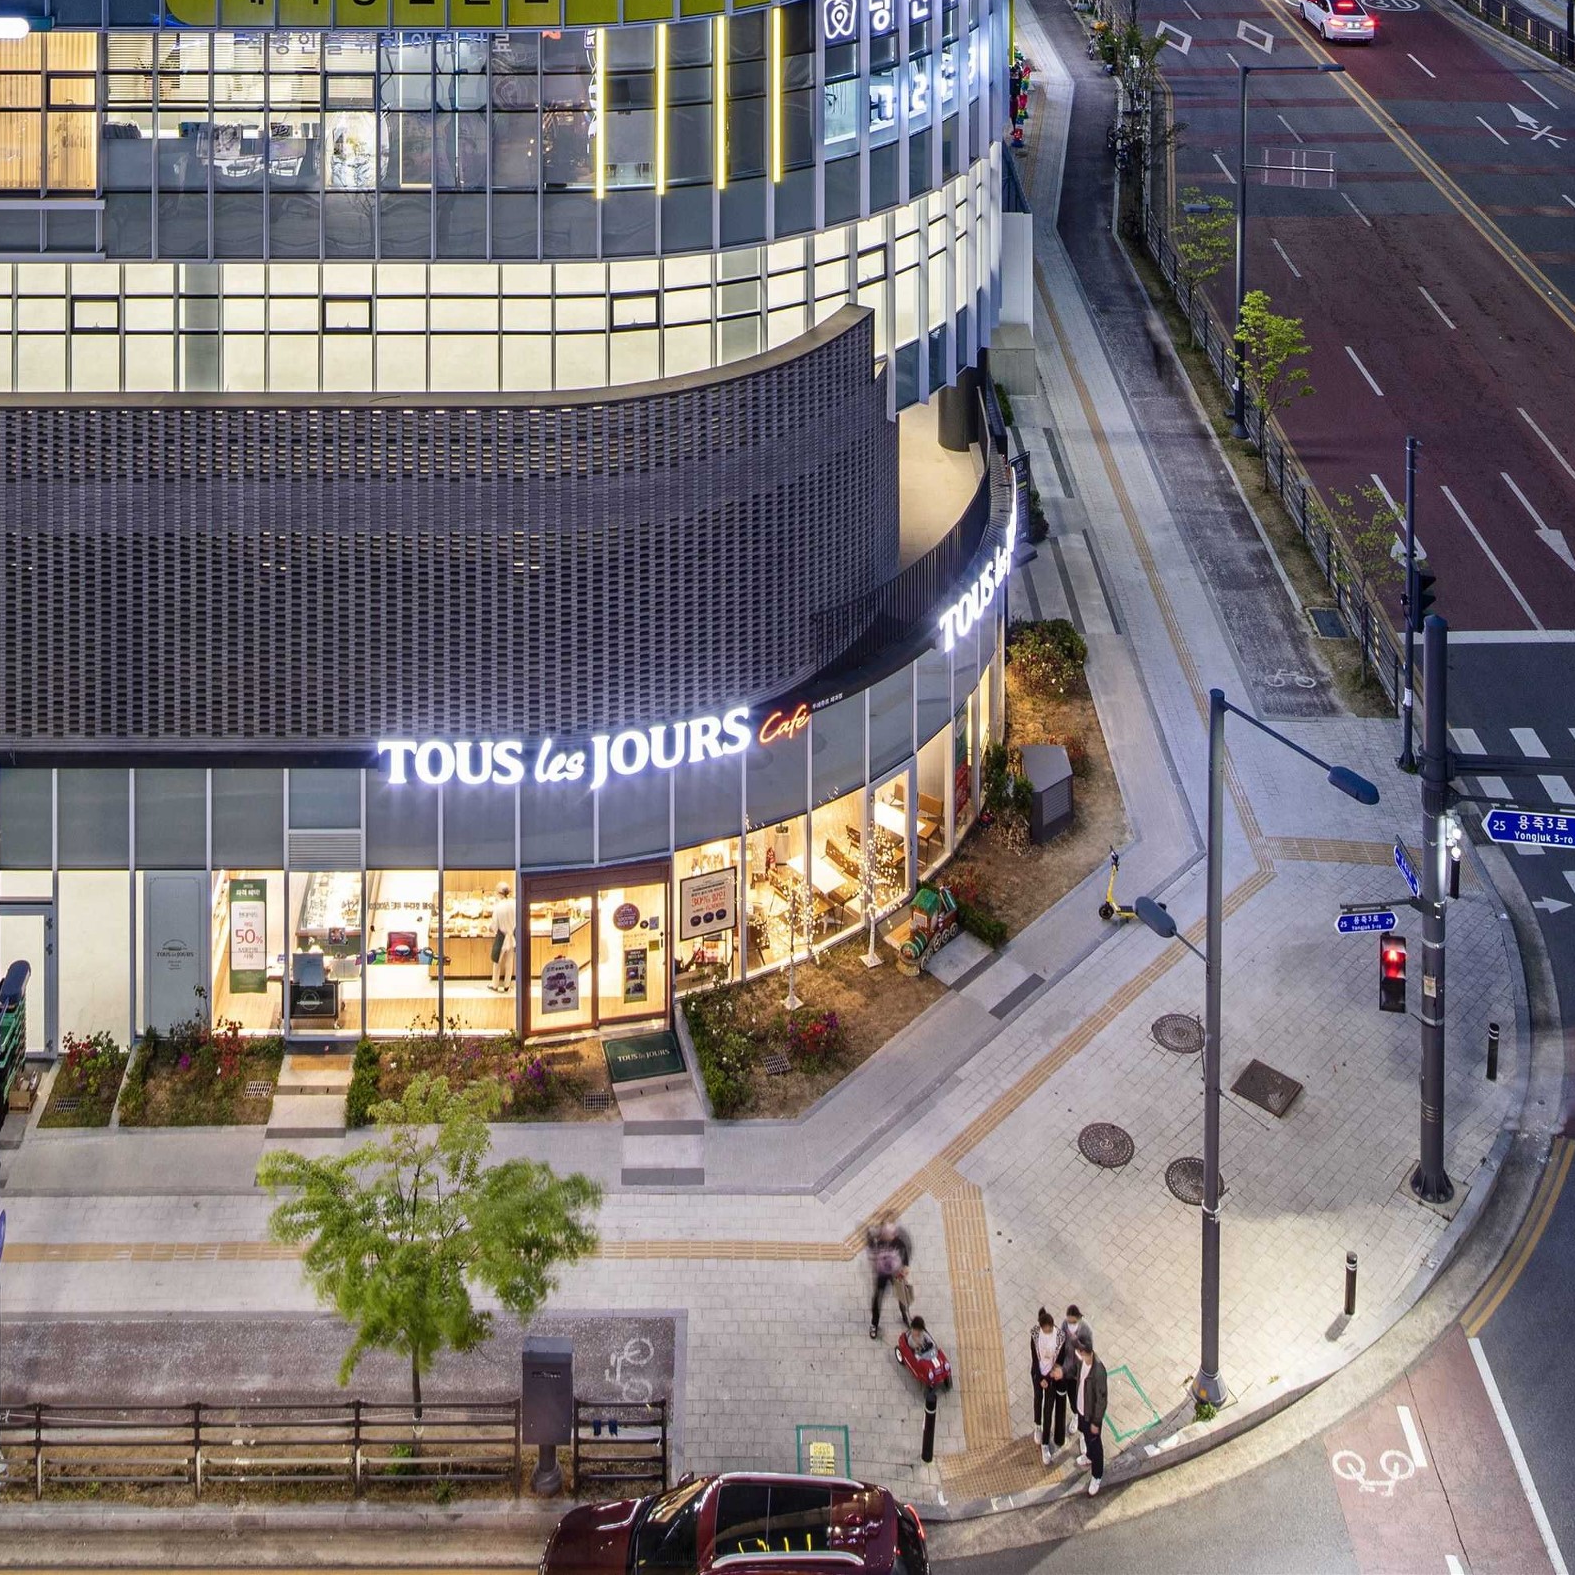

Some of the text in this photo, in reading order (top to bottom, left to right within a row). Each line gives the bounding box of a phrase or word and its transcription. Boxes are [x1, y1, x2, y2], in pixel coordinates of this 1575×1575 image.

[938, 560, 994, 653] TOUS
[377, 704, 810, 790] TOUS les JOURS Café
[1493, 819, 1506, 831] 25
[1517, 815, 1569, 831] 용죽3로
[1514, 830, 1573, 844] Yongjuk 3-ro
[1339, 915, 1393, 928] 25 용죽3로 29
[235, 928, 264, 945] 50%
[617, 1049, 670, 1062] TOUS JOURS
